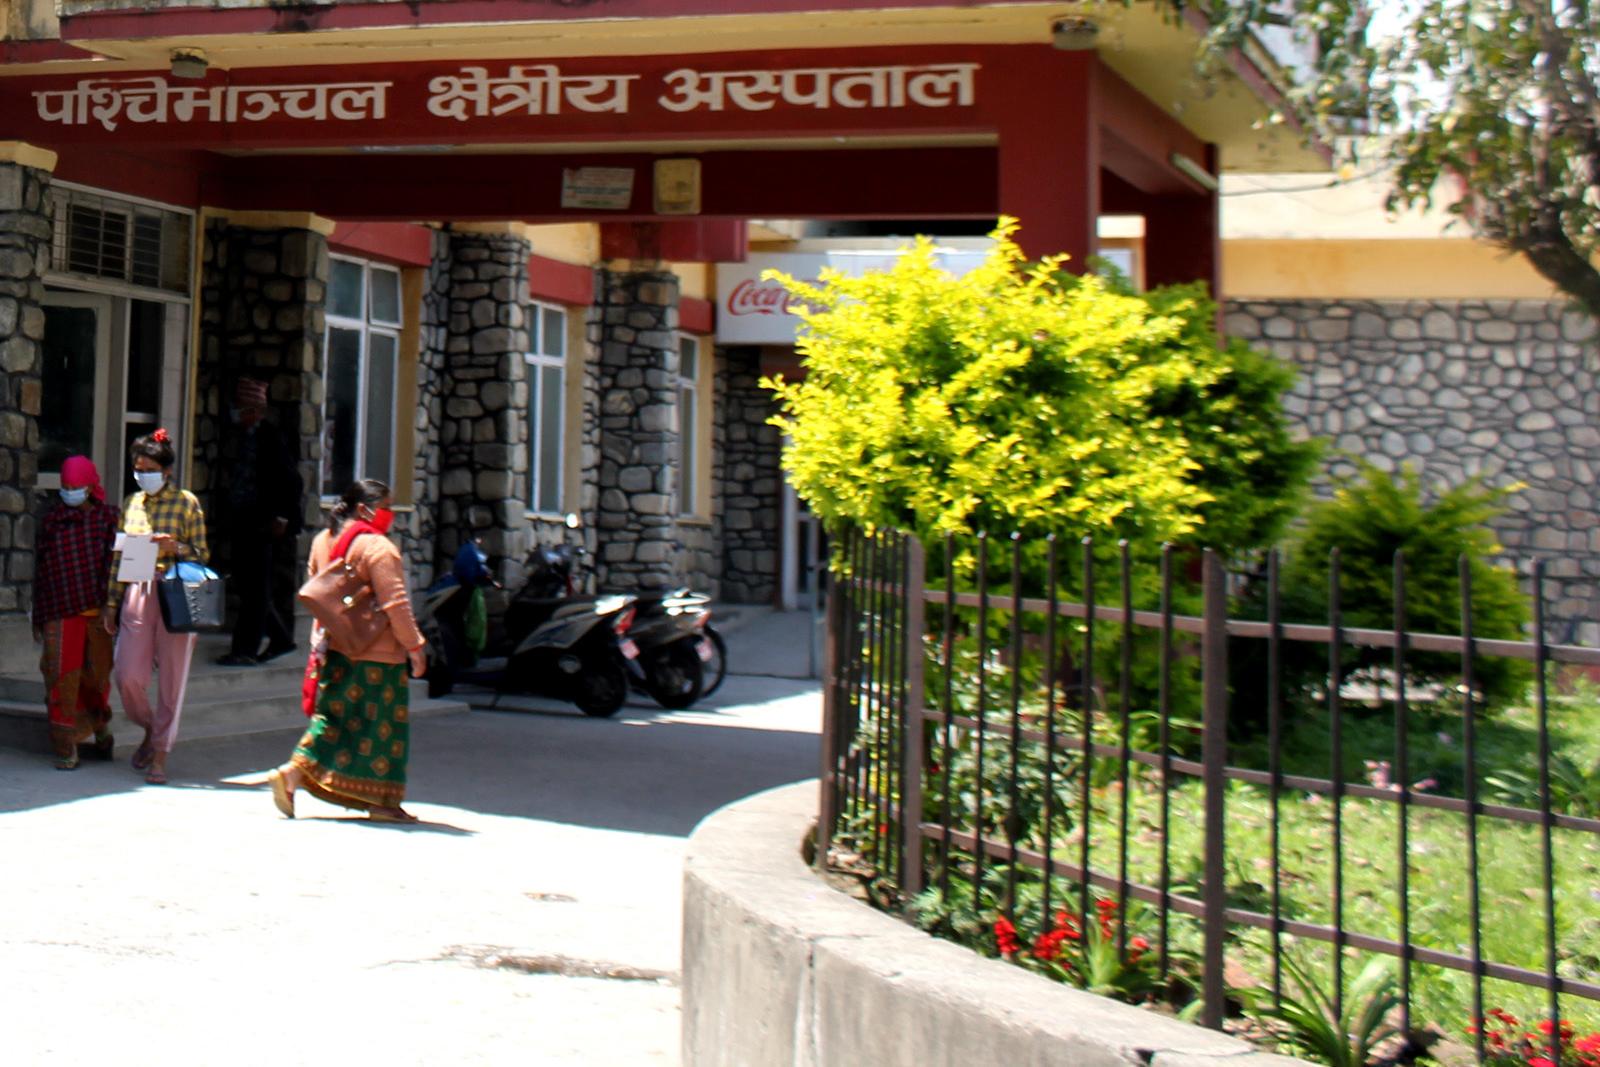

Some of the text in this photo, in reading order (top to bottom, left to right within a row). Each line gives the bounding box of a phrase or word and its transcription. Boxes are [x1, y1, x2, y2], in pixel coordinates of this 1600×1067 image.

[32, 62, 982, 131] पश्चिमाञ्चल क्षेत्रीय अस्पताल
